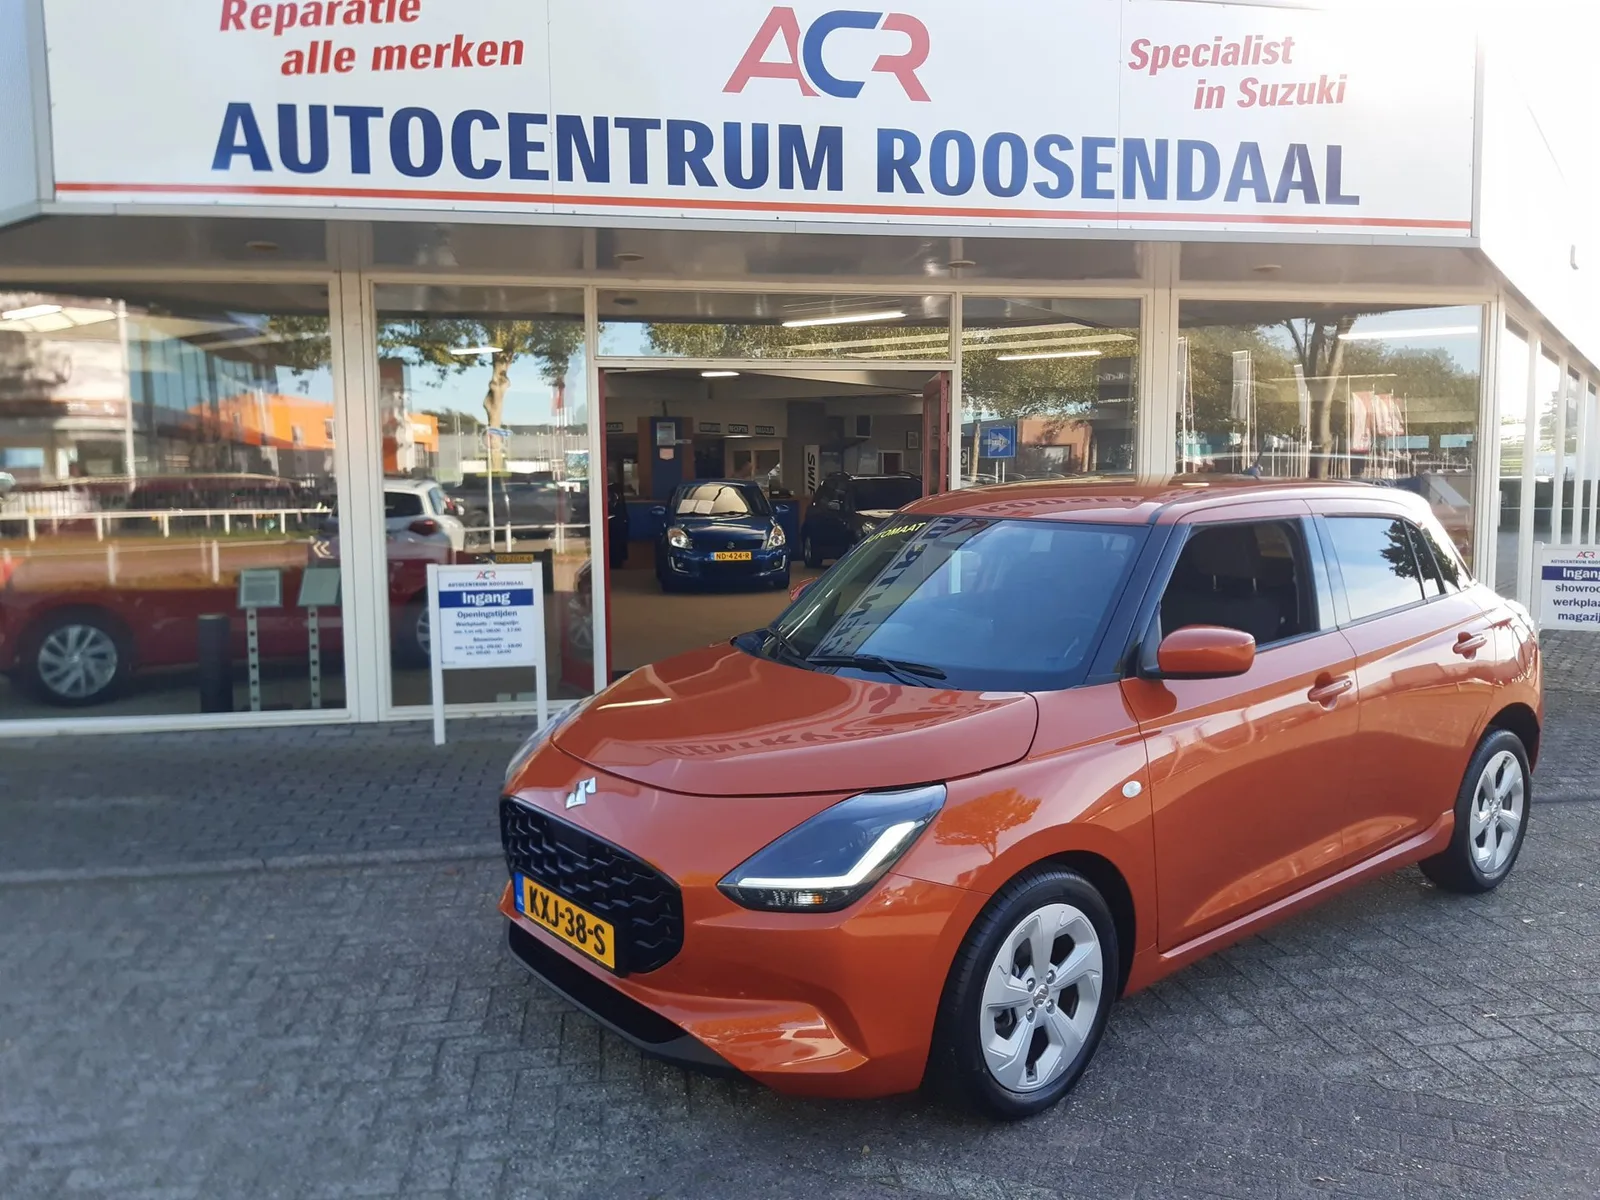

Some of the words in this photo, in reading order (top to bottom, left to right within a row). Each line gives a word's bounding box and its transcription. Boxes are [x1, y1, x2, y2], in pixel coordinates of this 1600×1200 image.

[219, 0, 421, 36] Reparatie
[280, 40, 356, 76] alle
[371, 34, 524, 71] merken
[722, 6, 932, 102] ACR
[1128, 35, 1296, 76] Specialist
[1194, 79, 1226, 109] in
[1237, 74, 1348, 108] Suzuki
[211, 102, 843, 191] AUTOCENTRUM
[876, 128, 1360, 206] ROOSENDAAL
[807, 452, 816, 495] SWIF
[865, 522, 927, 543] UTOMAAT
[1576, 551, 1596, 559] ACR
[476, 570, 496, 579] ACR
[457, 610, 518, 619] Openingstijden
[462, 591, 511, 606] Ingang
[529, 885, 606, 956] KXJ-38-S
